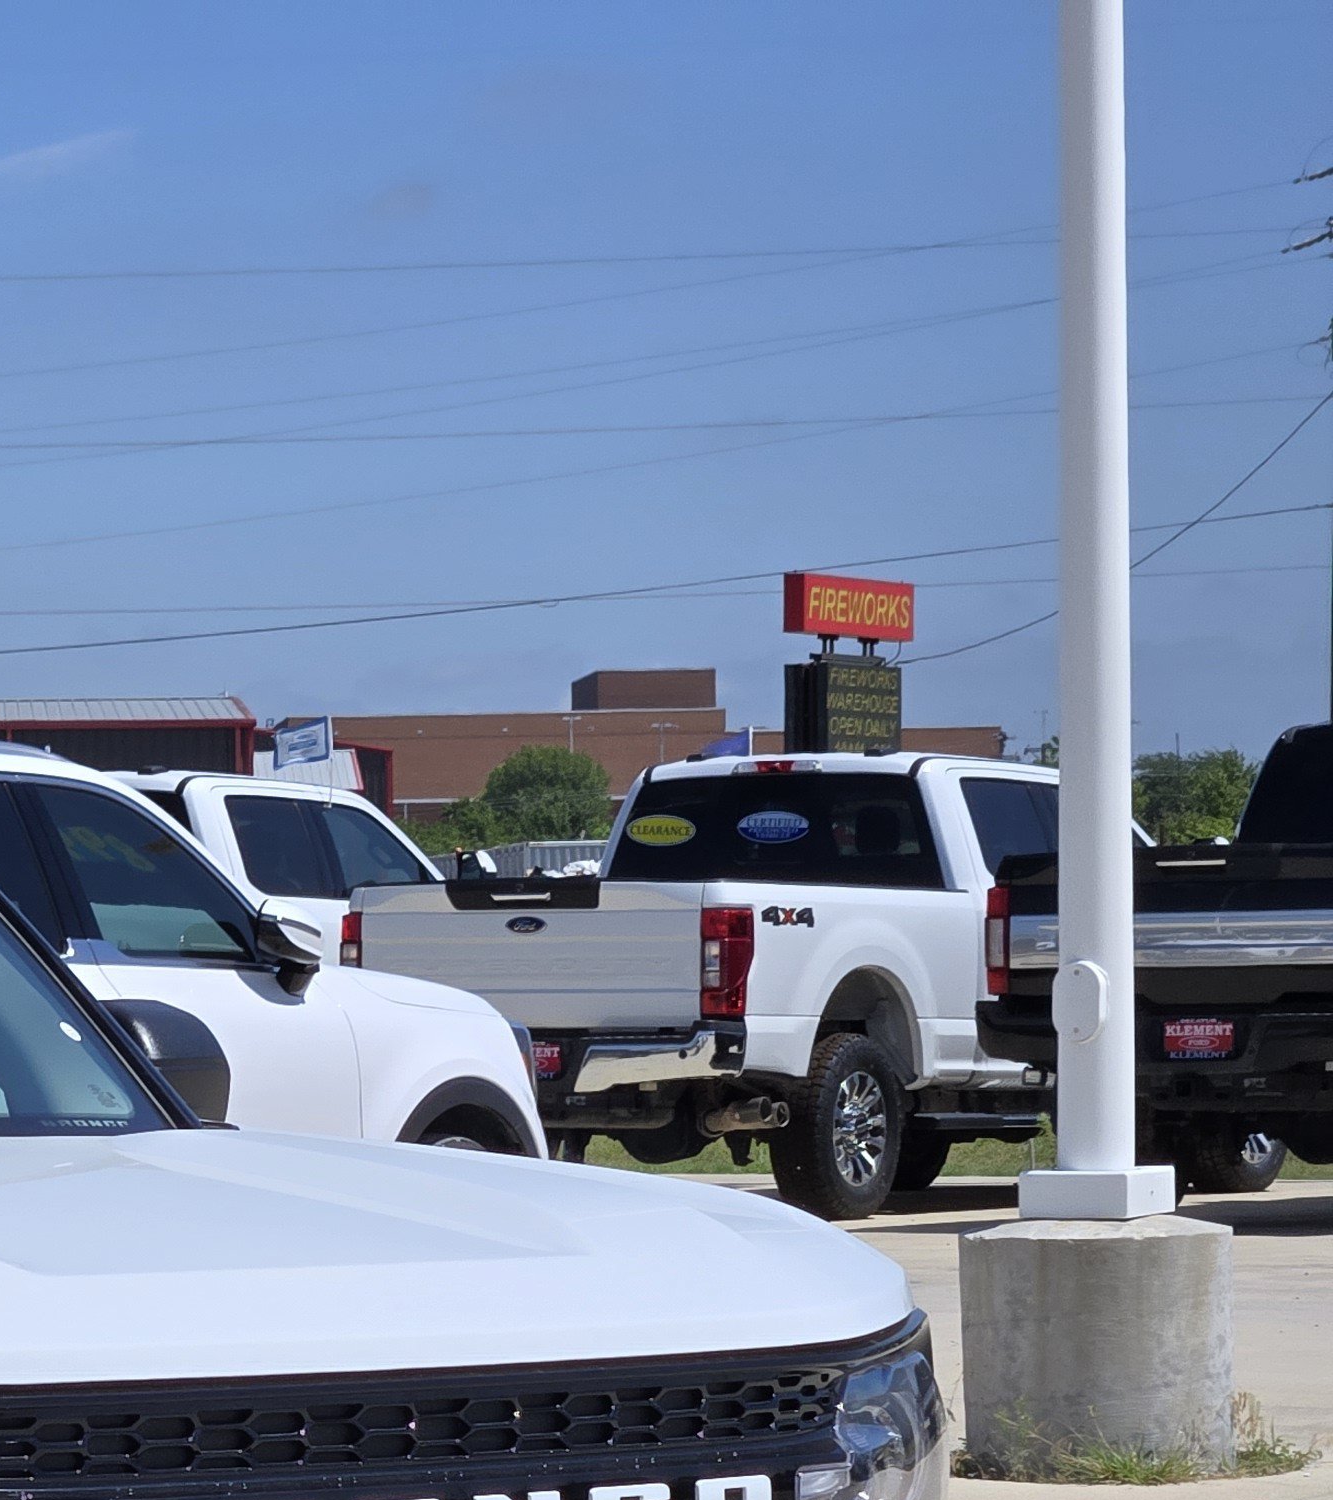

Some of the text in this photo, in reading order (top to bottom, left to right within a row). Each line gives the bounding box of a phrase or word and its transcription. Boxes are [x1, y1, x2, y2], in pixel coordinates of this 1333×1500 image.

[808, 586, 911, 629] FIREWORKS
[828, 667, 898, 689] FIREWORKS
[826, 692, 898, 714] WAREHOUSE
[828, 716, 897, 738] OPEN DAILY
[630, 825, 691, 837] CLEARANCE
[746, 817, 803, 828] CERTIFIED
[761, 906, 815, 928] 4x4
[1165, 1024, 1233, 1036] KLEMENT
